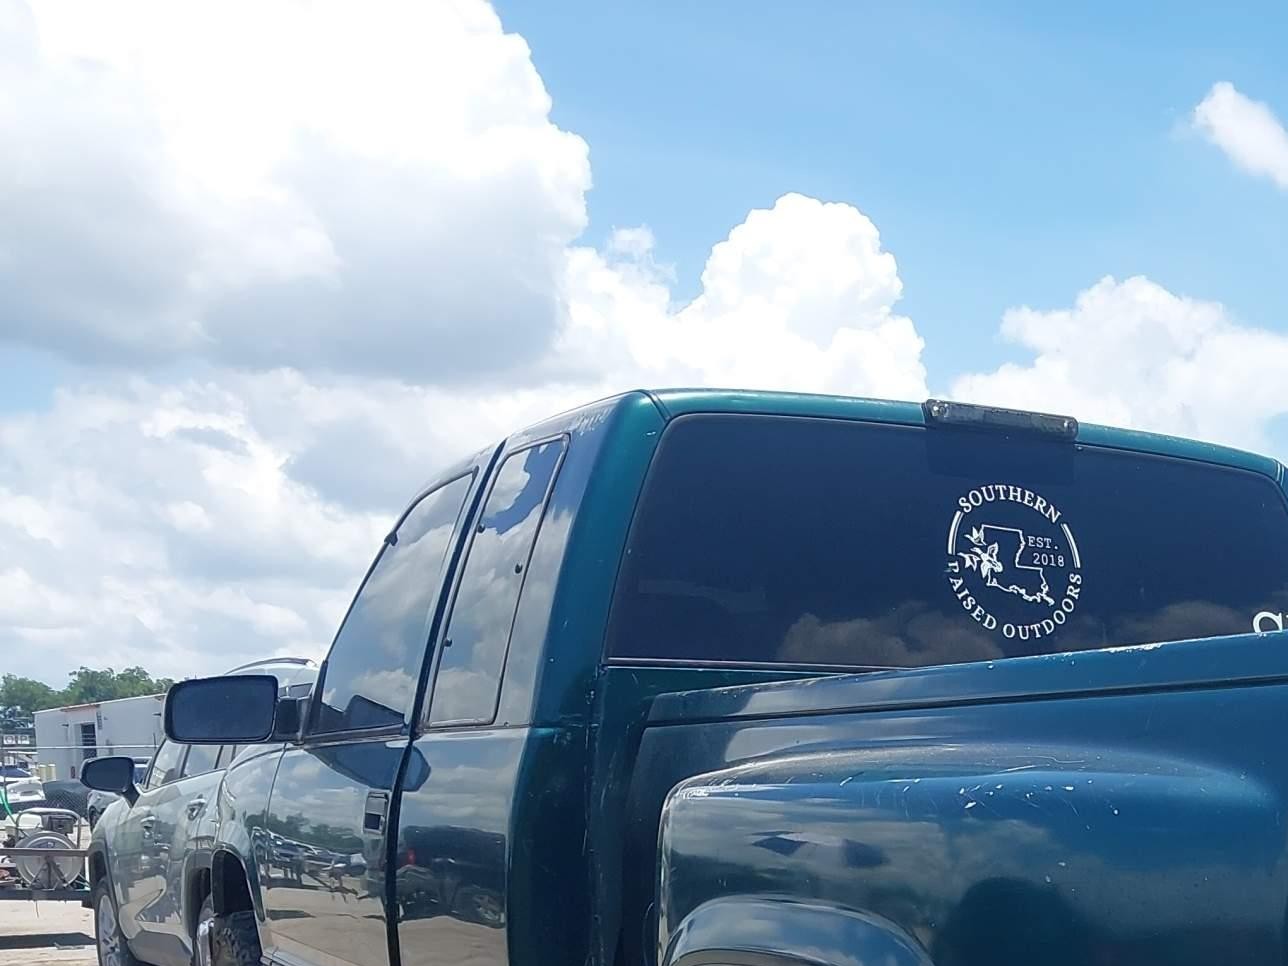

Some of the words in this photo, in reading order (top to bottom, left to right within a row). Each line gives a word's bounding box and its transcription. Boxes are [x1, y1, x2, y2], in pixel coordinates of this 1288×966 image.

[959, 485, 1061, 523] SOUTHERN
[1028, 536, 1058, 549] EST.
[1033, 553, 1064, 567] 2018
[1003, 573, 1082, 639] OUTDOORS
